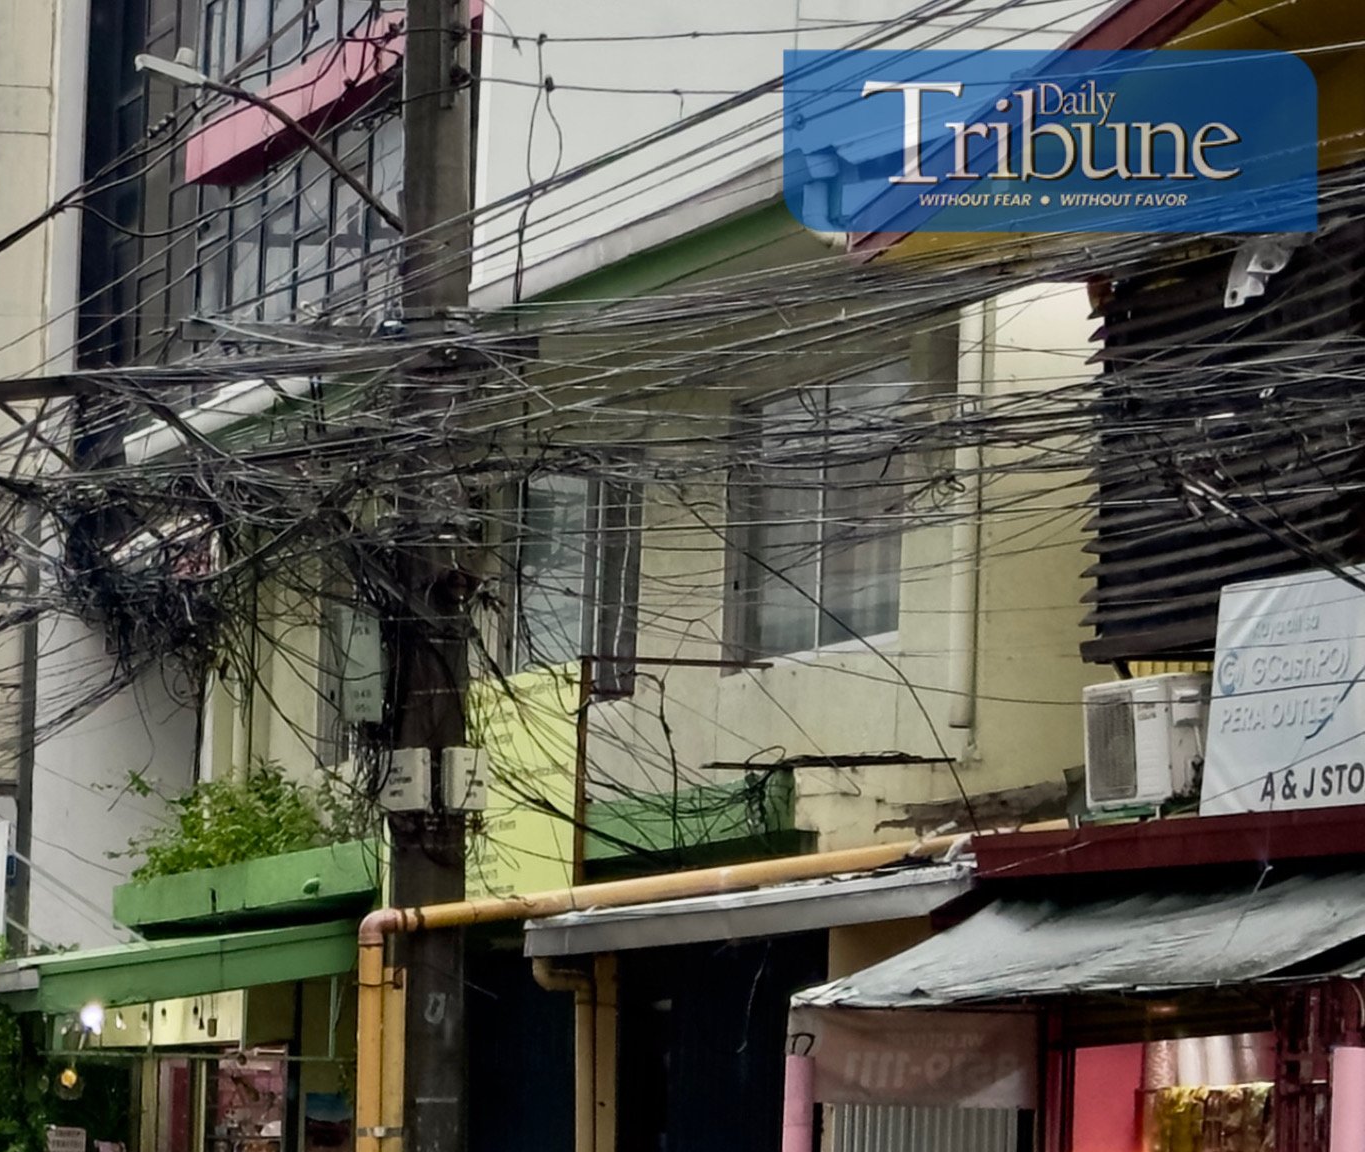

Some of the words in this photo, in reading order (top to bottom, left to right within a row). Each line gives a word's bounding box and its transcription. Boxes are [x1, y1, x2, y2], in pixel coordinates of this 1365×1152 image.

[1220, 702, 1266, 733] PERA
[1272, 694, 1340, 729] OUTLET
[1260, 771, 1275, 802] A
[1281, 770, 1297, 800] &
[1303, 767, 1315, 798] J
[1321, 761, 1365, 797] STO
